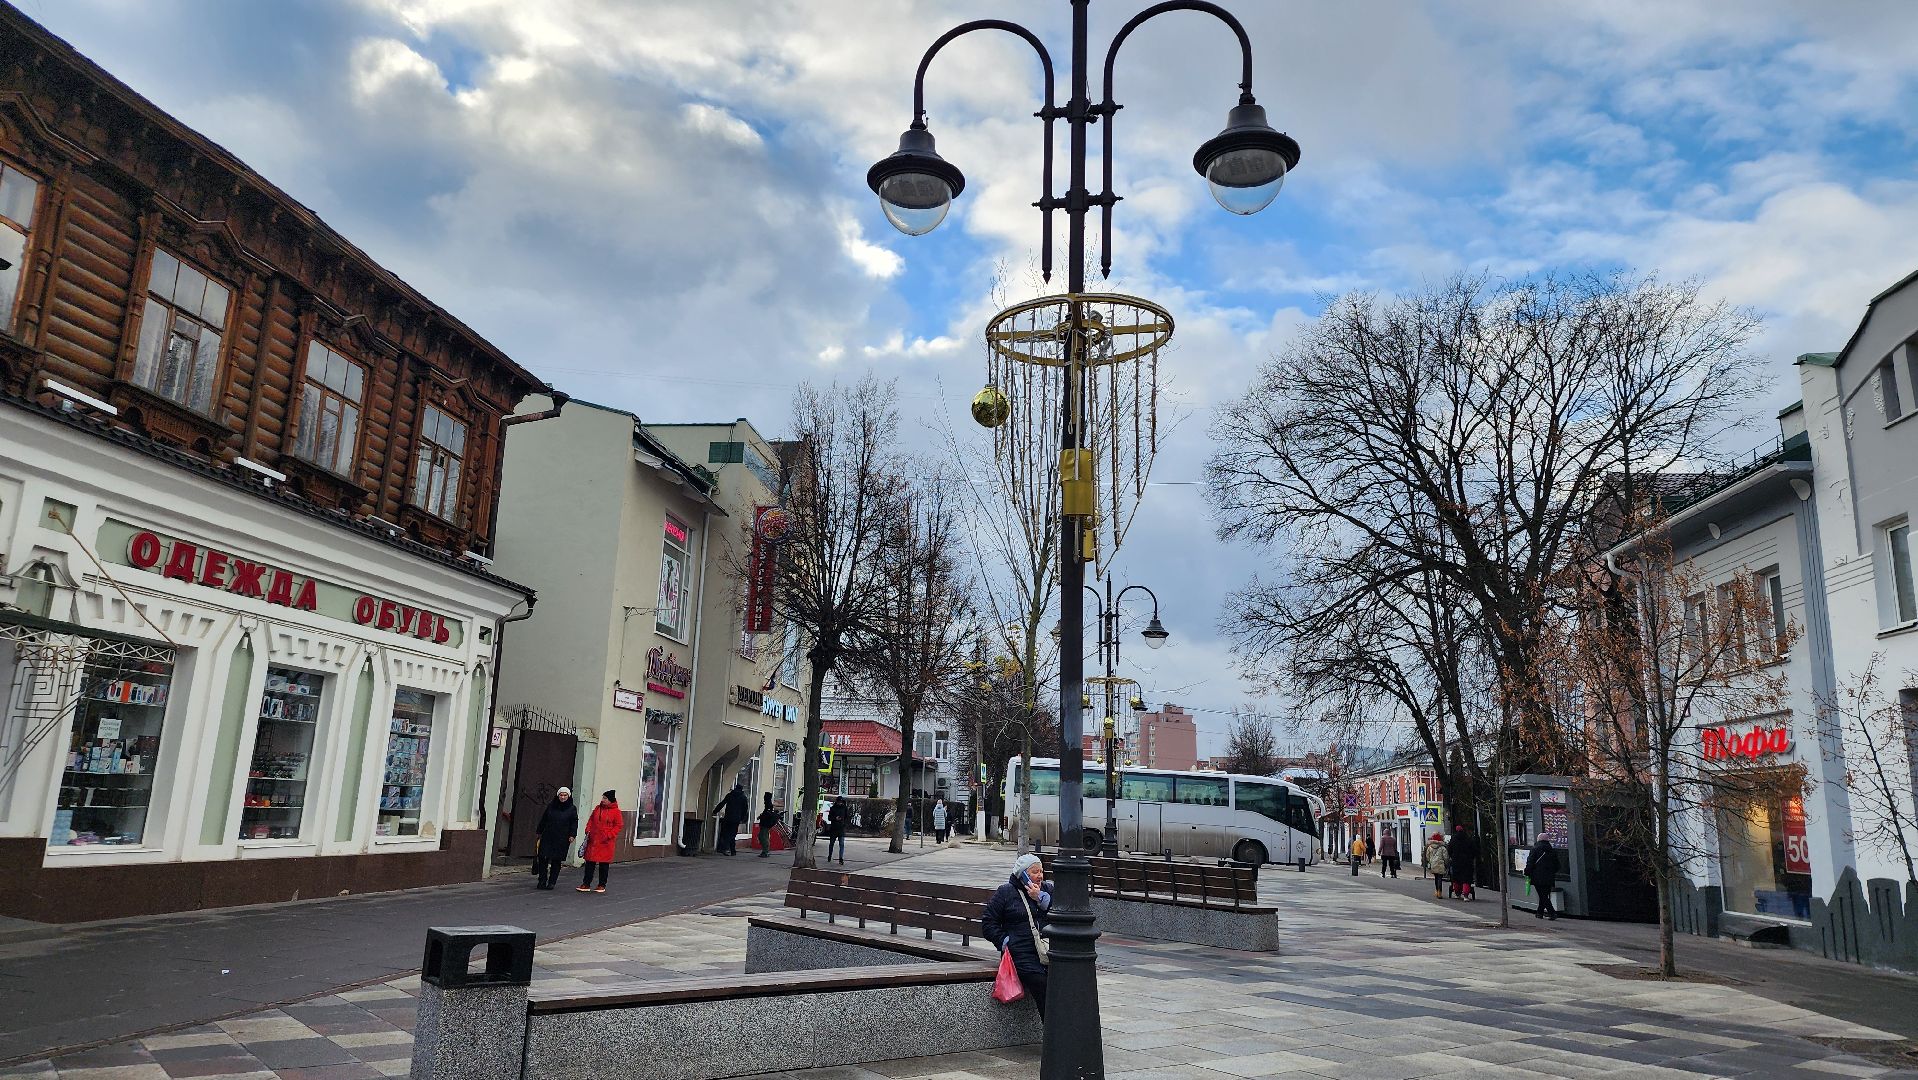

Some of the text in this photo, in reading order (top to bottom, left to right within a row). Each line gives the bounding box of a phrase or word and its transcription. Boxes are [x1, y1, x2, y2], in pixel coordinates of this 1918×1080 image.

[128, 531, 317, 611] ОДЕЖДА
[353, 595, 450, 643] ОБУВЬ
[754, 598, 763, 630] КИНГ
[1788, 835, 1811, 864] 50
